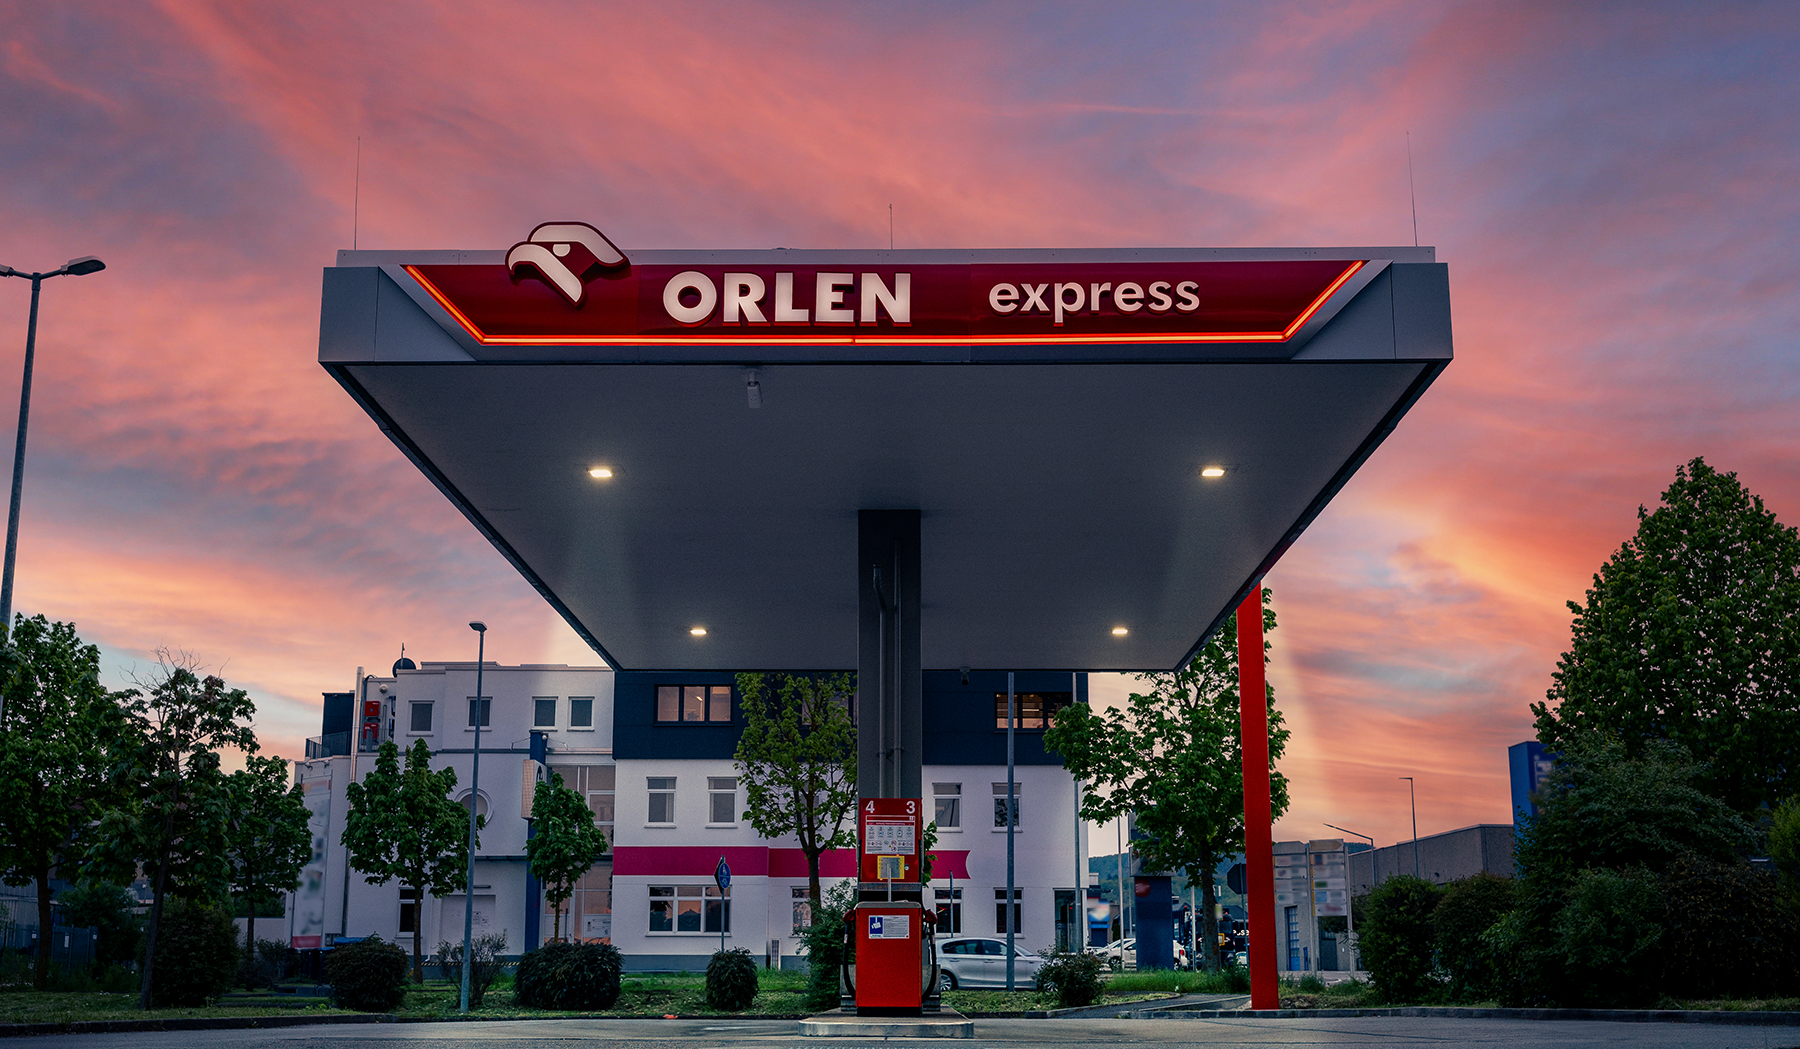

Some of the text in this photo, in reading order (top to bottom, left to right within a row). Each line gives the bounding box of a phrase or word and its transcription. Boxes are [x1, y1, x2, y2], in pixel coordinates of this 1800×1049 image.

[662, 270, 1201, 325] ORLEN express
[865, 800, 875, 814] 4
[906, 800, 916, 815] 3
